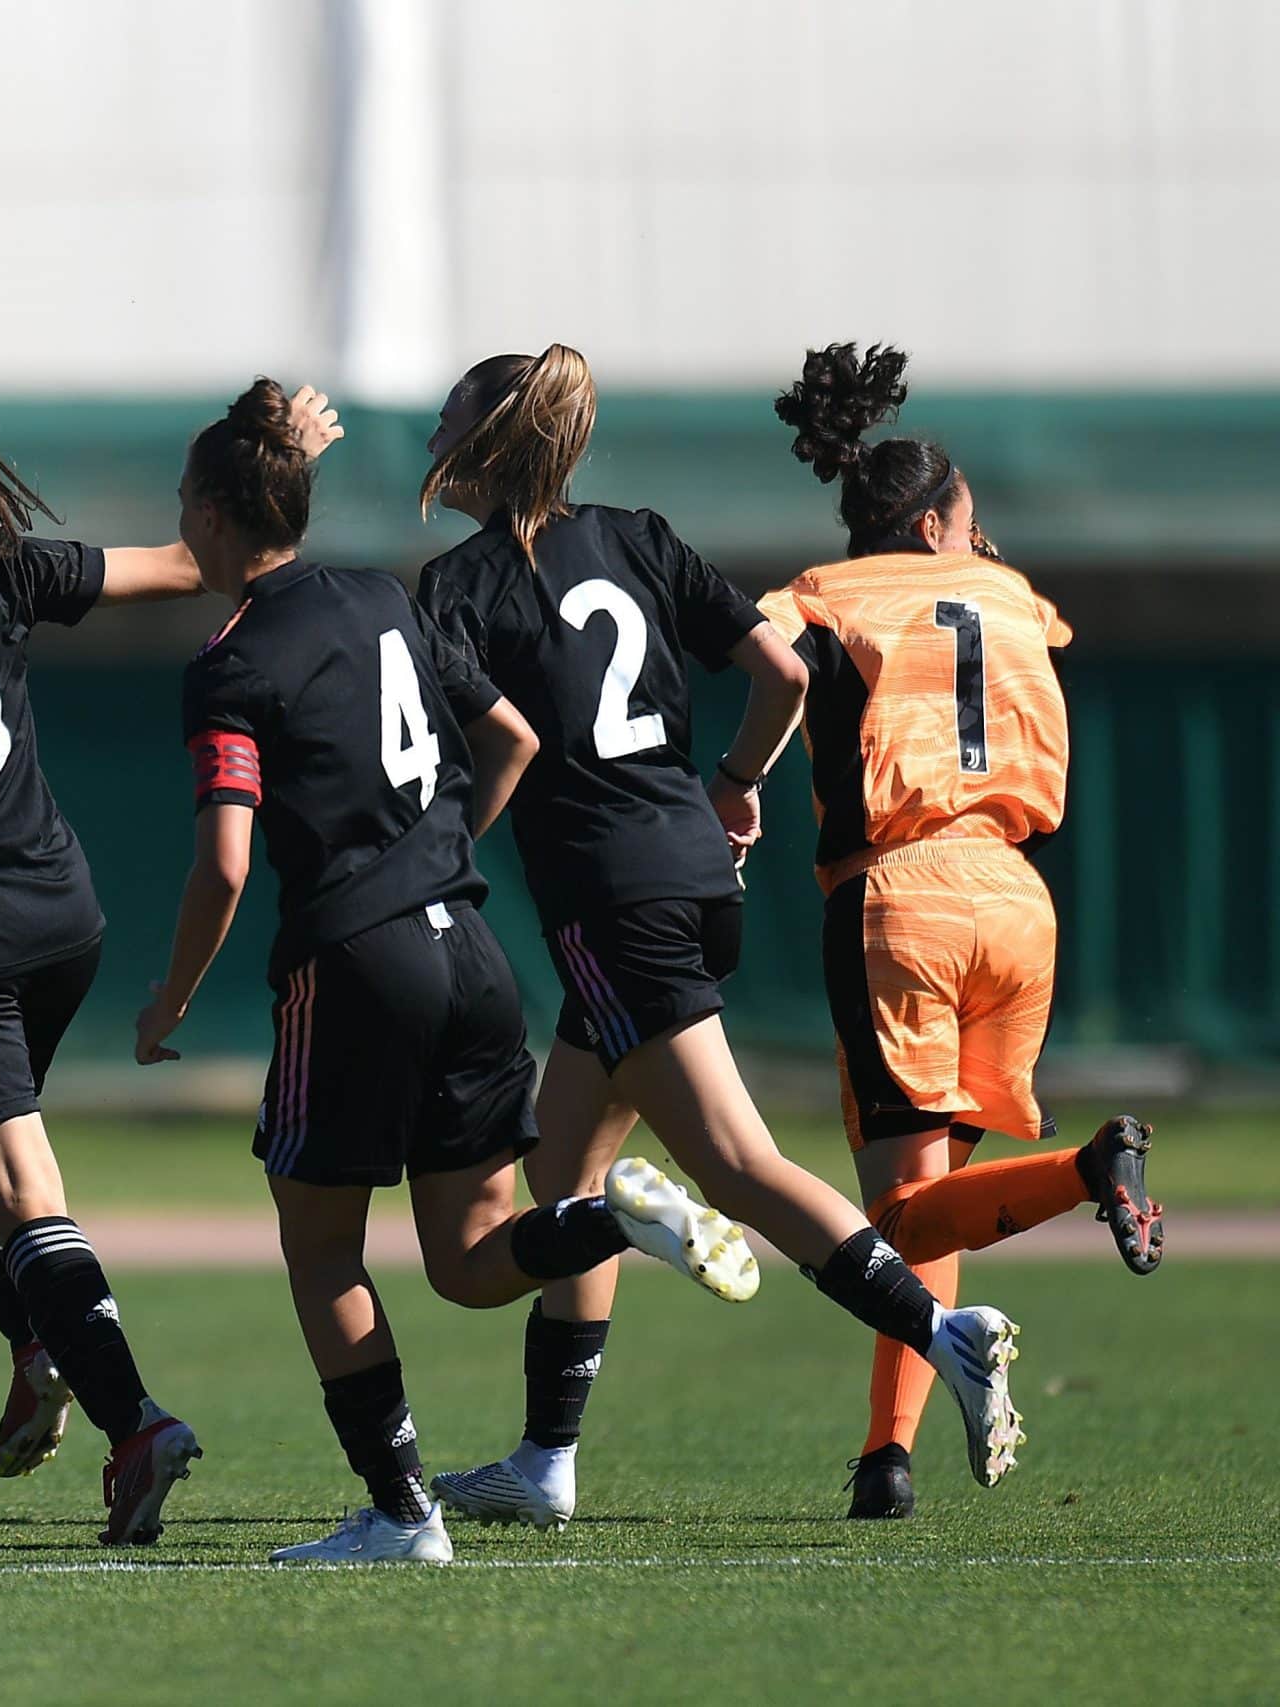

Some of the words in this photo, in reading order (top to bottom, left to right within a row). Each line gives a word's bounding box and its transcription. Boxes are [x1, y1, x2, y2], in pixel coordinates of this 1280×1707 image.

[379, 629, 440, 811] 4
[560, 578, 666, 759] 2
[934, 600, 990, 774] 1
